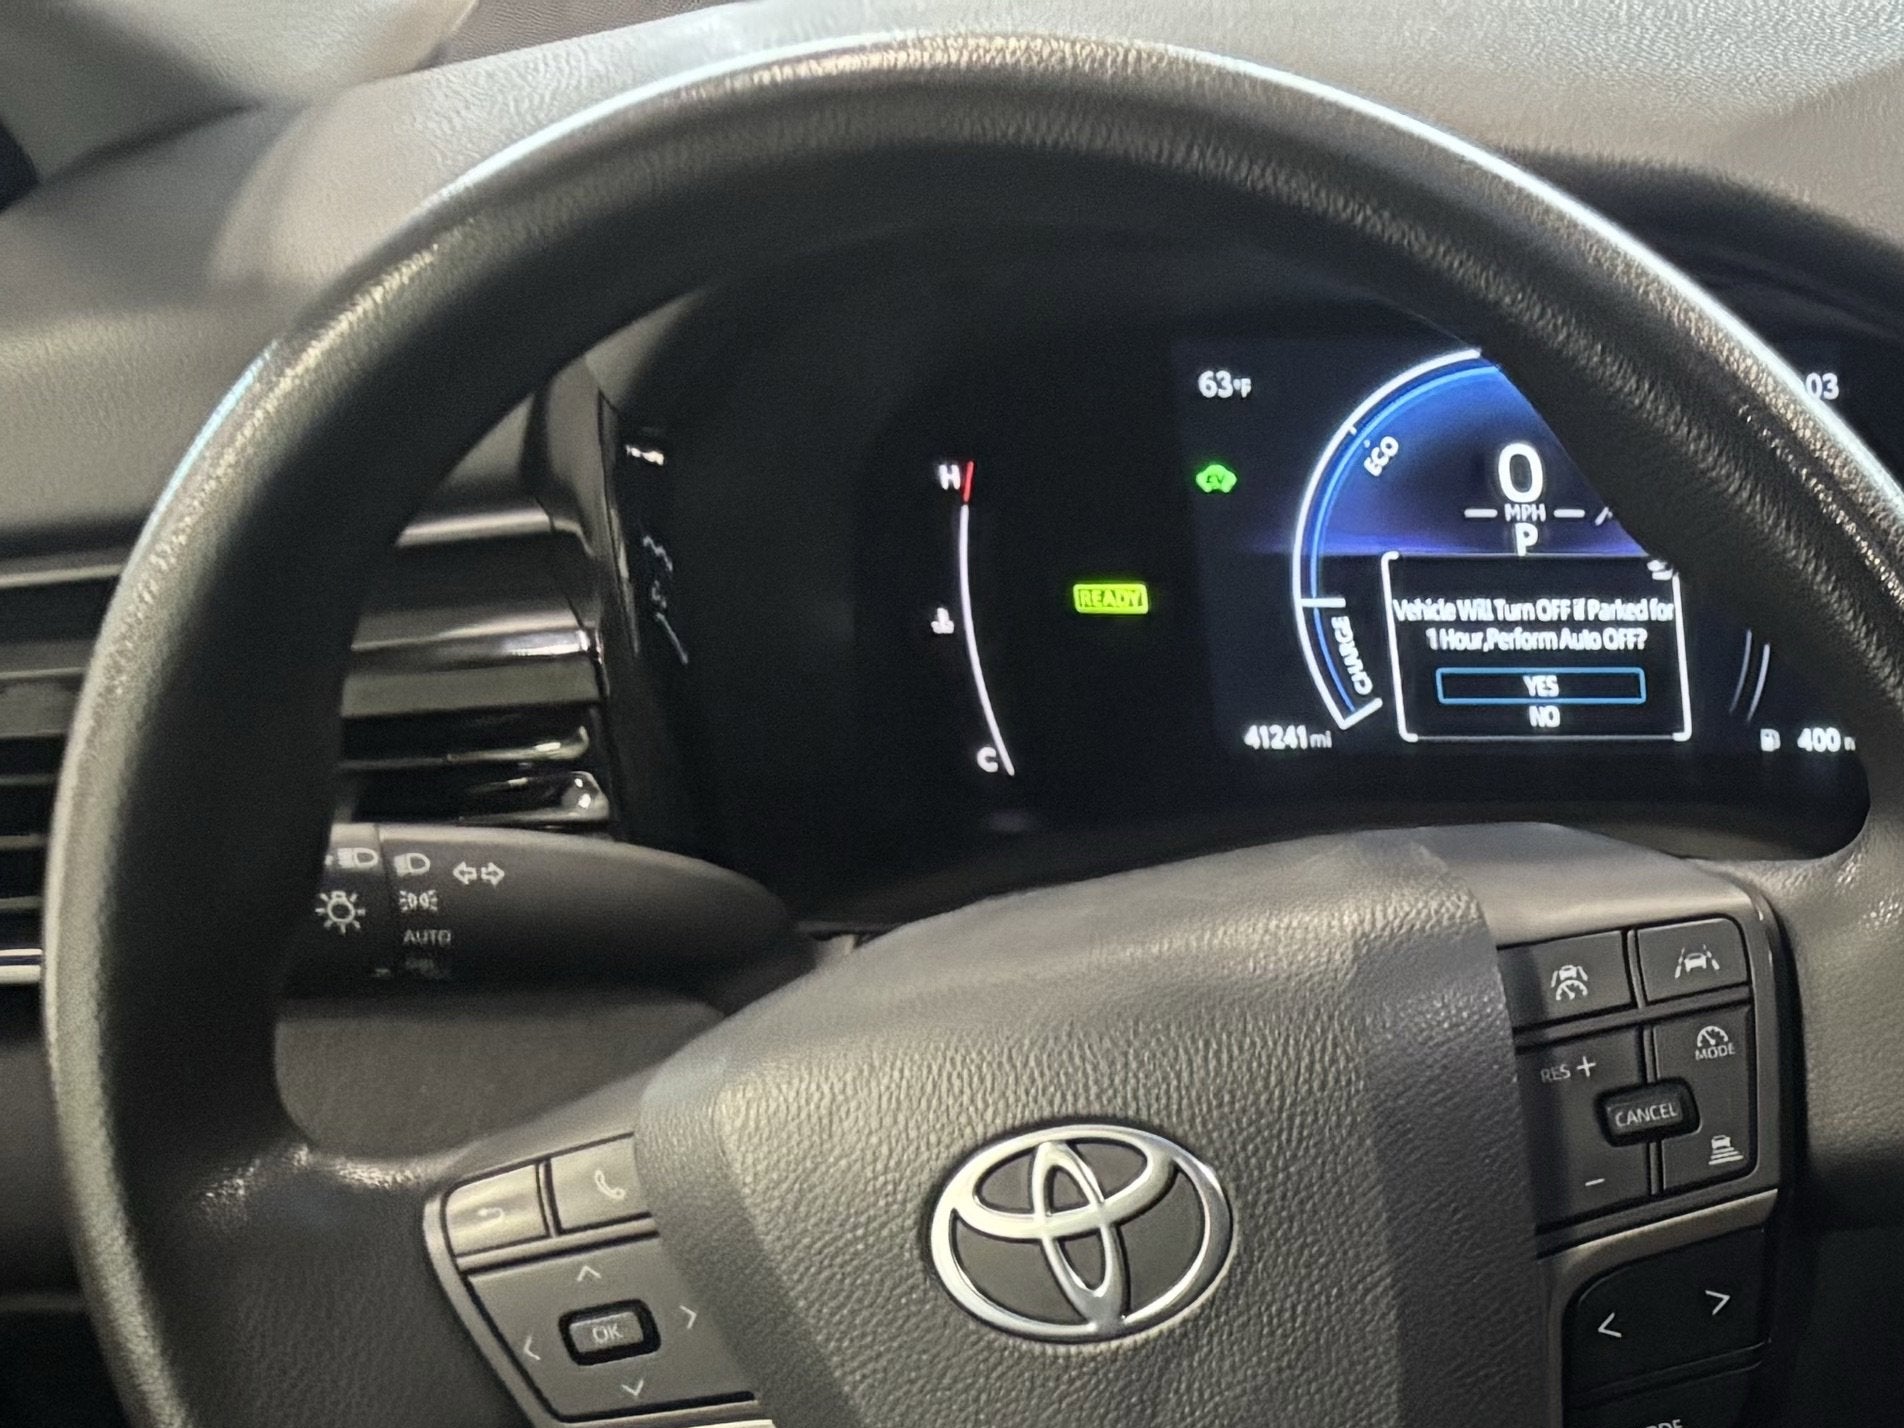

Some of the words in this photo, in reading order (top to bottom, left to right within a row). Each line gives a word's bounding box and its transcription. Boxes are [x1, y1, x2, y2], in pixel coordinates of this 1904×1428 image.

[1363, 436, 1399, 477] ECO
[938, 464, 961, 491] H
[1504, 503, 1547, 522] MPH
[1515, 522, 1539, 557] P
[1078, 588, 1145, 608] READY
[1392, 598, 1457, 622] Vehicle
[1457, 598, 1494, 622] Will
[1494, 598, 1535, 622] Turn
[1536, 598, 1571, 622] OFF
[1586, 597, 1649, 622] Parked
[1649, 597, 1674, 622] for
[1559, 627, 1601, 651] Auto
[1602, 627, 1648, 650] OFF?
[1331, 615, 1374, 695] CHARGE
[1523, 675, 1560, 697] YES
[1528, 705, 1561, 728] NO
[1243, 725, 1308, 750] 41241
[1310, 730, 1332, 748] mi
[1797, 727, 1842, 753] 400
[977, 748, 998, 774] C
[403, 929, 452, 947] AUTO
[1695, 1041, 1736, 1061] MODE
[1540, 1063, 1571, 1083] RES
[1614, 1101, 1679, 1127] CANCEL
[593, 1322, 623, 1344] OK
